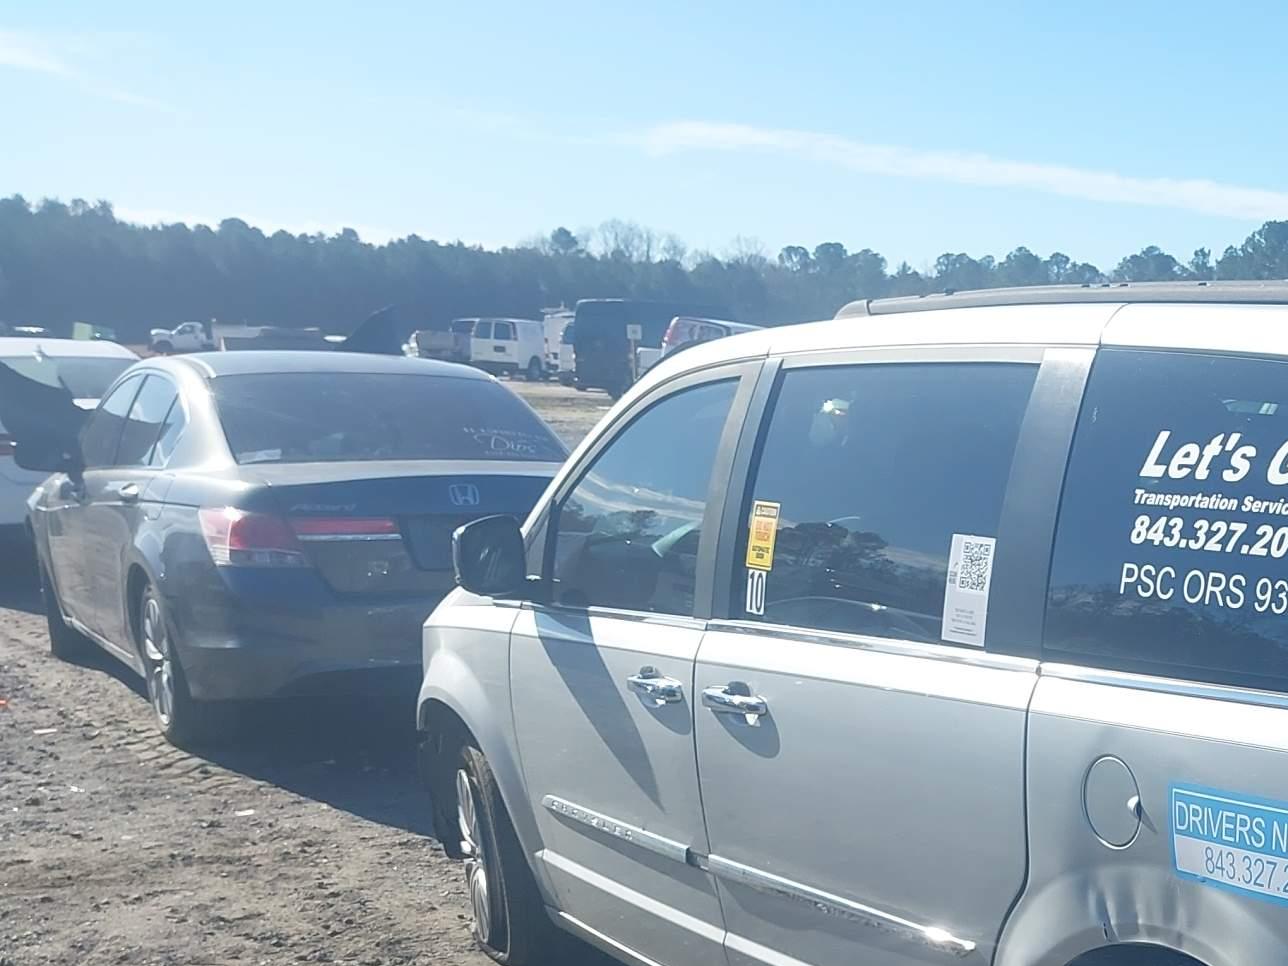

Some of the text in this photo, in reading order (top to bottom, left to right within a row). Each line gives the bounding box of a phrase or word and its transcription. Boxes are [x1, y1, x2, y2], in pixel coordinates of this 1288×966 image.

[1139, 430, 1256, 483] Let's
[1134, 488, 1237, 512] Transportation
[750, 570, 764, 613] 10
[1119, 562, 1176, 600] PSC
[1183, 569, 1246, 609] ORS
[1175, 801, 1265, 848] DRIVERS
